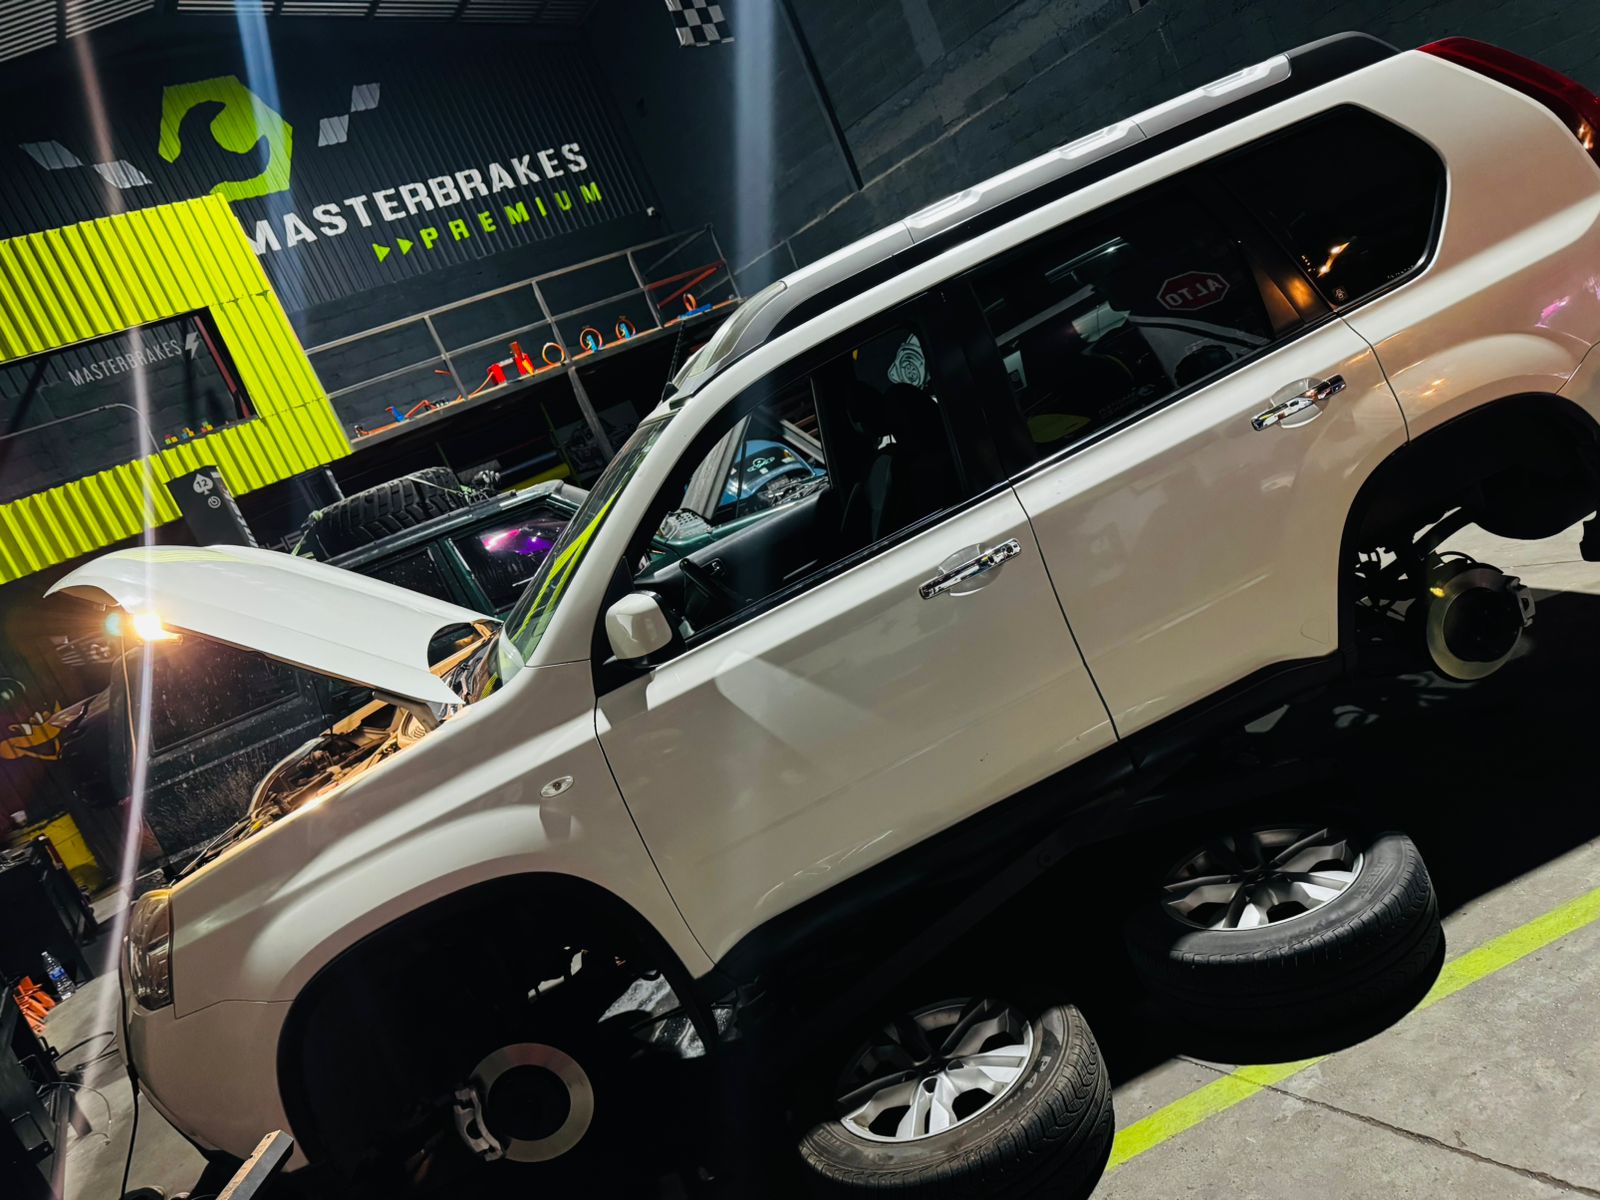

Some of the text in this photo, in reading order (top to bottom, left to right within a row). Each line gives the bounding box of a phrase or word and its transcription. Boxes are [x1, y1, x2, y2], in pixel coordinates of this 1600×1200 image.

[246, 142, 588, 256] MASTERBRAKES
[420, 182, 602, 249] PREMIUM
[68, 340, 182, 387] MASTERBRAKES
[196, 478, 209, 489] 12
